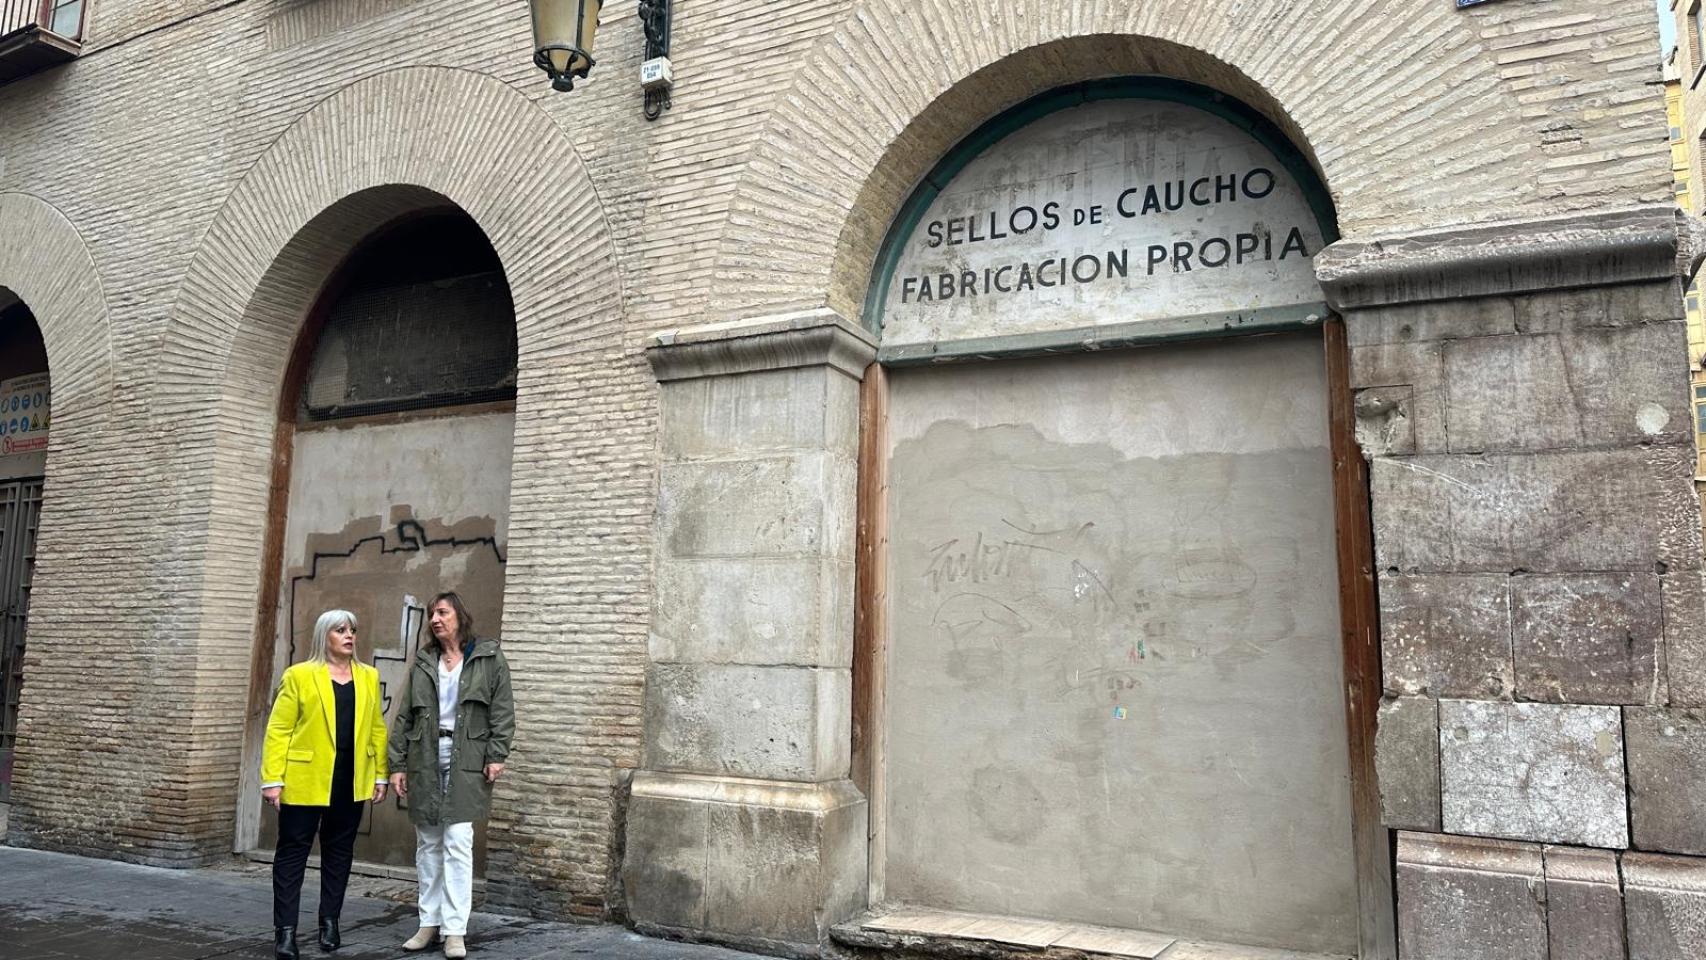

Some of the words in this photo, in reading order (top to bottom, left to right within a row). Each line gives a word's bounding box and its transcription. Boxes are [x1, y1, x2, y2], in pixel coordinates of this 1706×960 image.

[927, 201, 1061, 249] SELLOS
[1073, 205, 1103, 227] DE
[1116, 167, 1276, 219] CAUCHO
[901, 252, 1128, 304] FABRICACION
[1147, 226, 1309, 276] PROPIA
